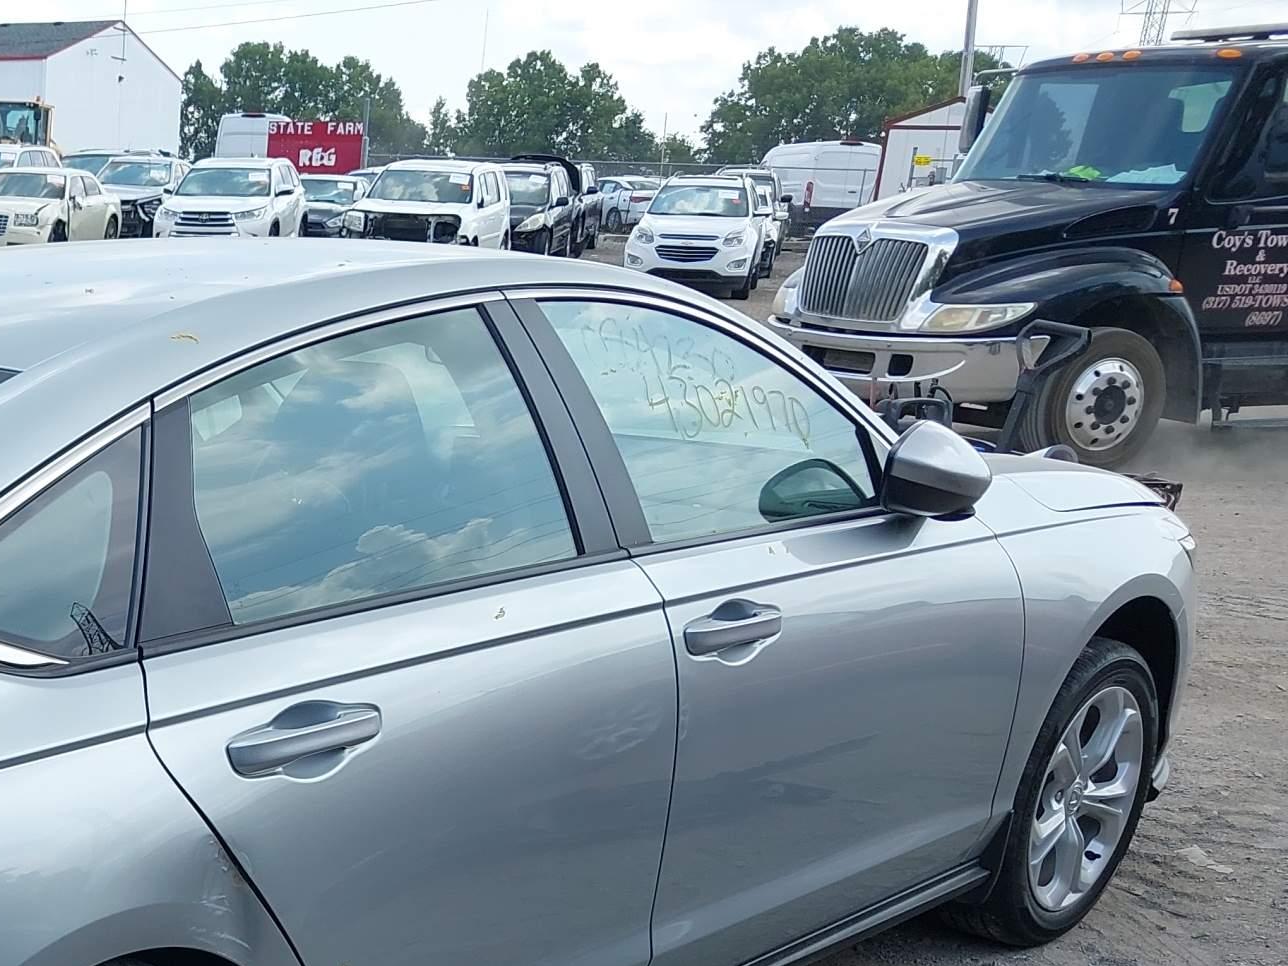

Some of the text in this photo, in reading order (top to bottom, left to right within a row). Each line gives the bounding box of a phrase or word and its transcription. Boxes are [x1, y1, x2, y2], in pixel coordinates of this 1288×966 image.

[269, 122, 363, 135] STATE FARM
[1168, 208, 1179, 225] 7
[1212, 230, 1254, 252] Coy's
[1255, 249, 1266, 261] &
[1222, 260, 1288, 278] Recovery
[1217, 284, 1252, 295] USDOT
[1202, 296, 1230, 311] (317)
[1245, 311, 1283, 327] (8697)
[643, 374, 812, 449] 43021970
